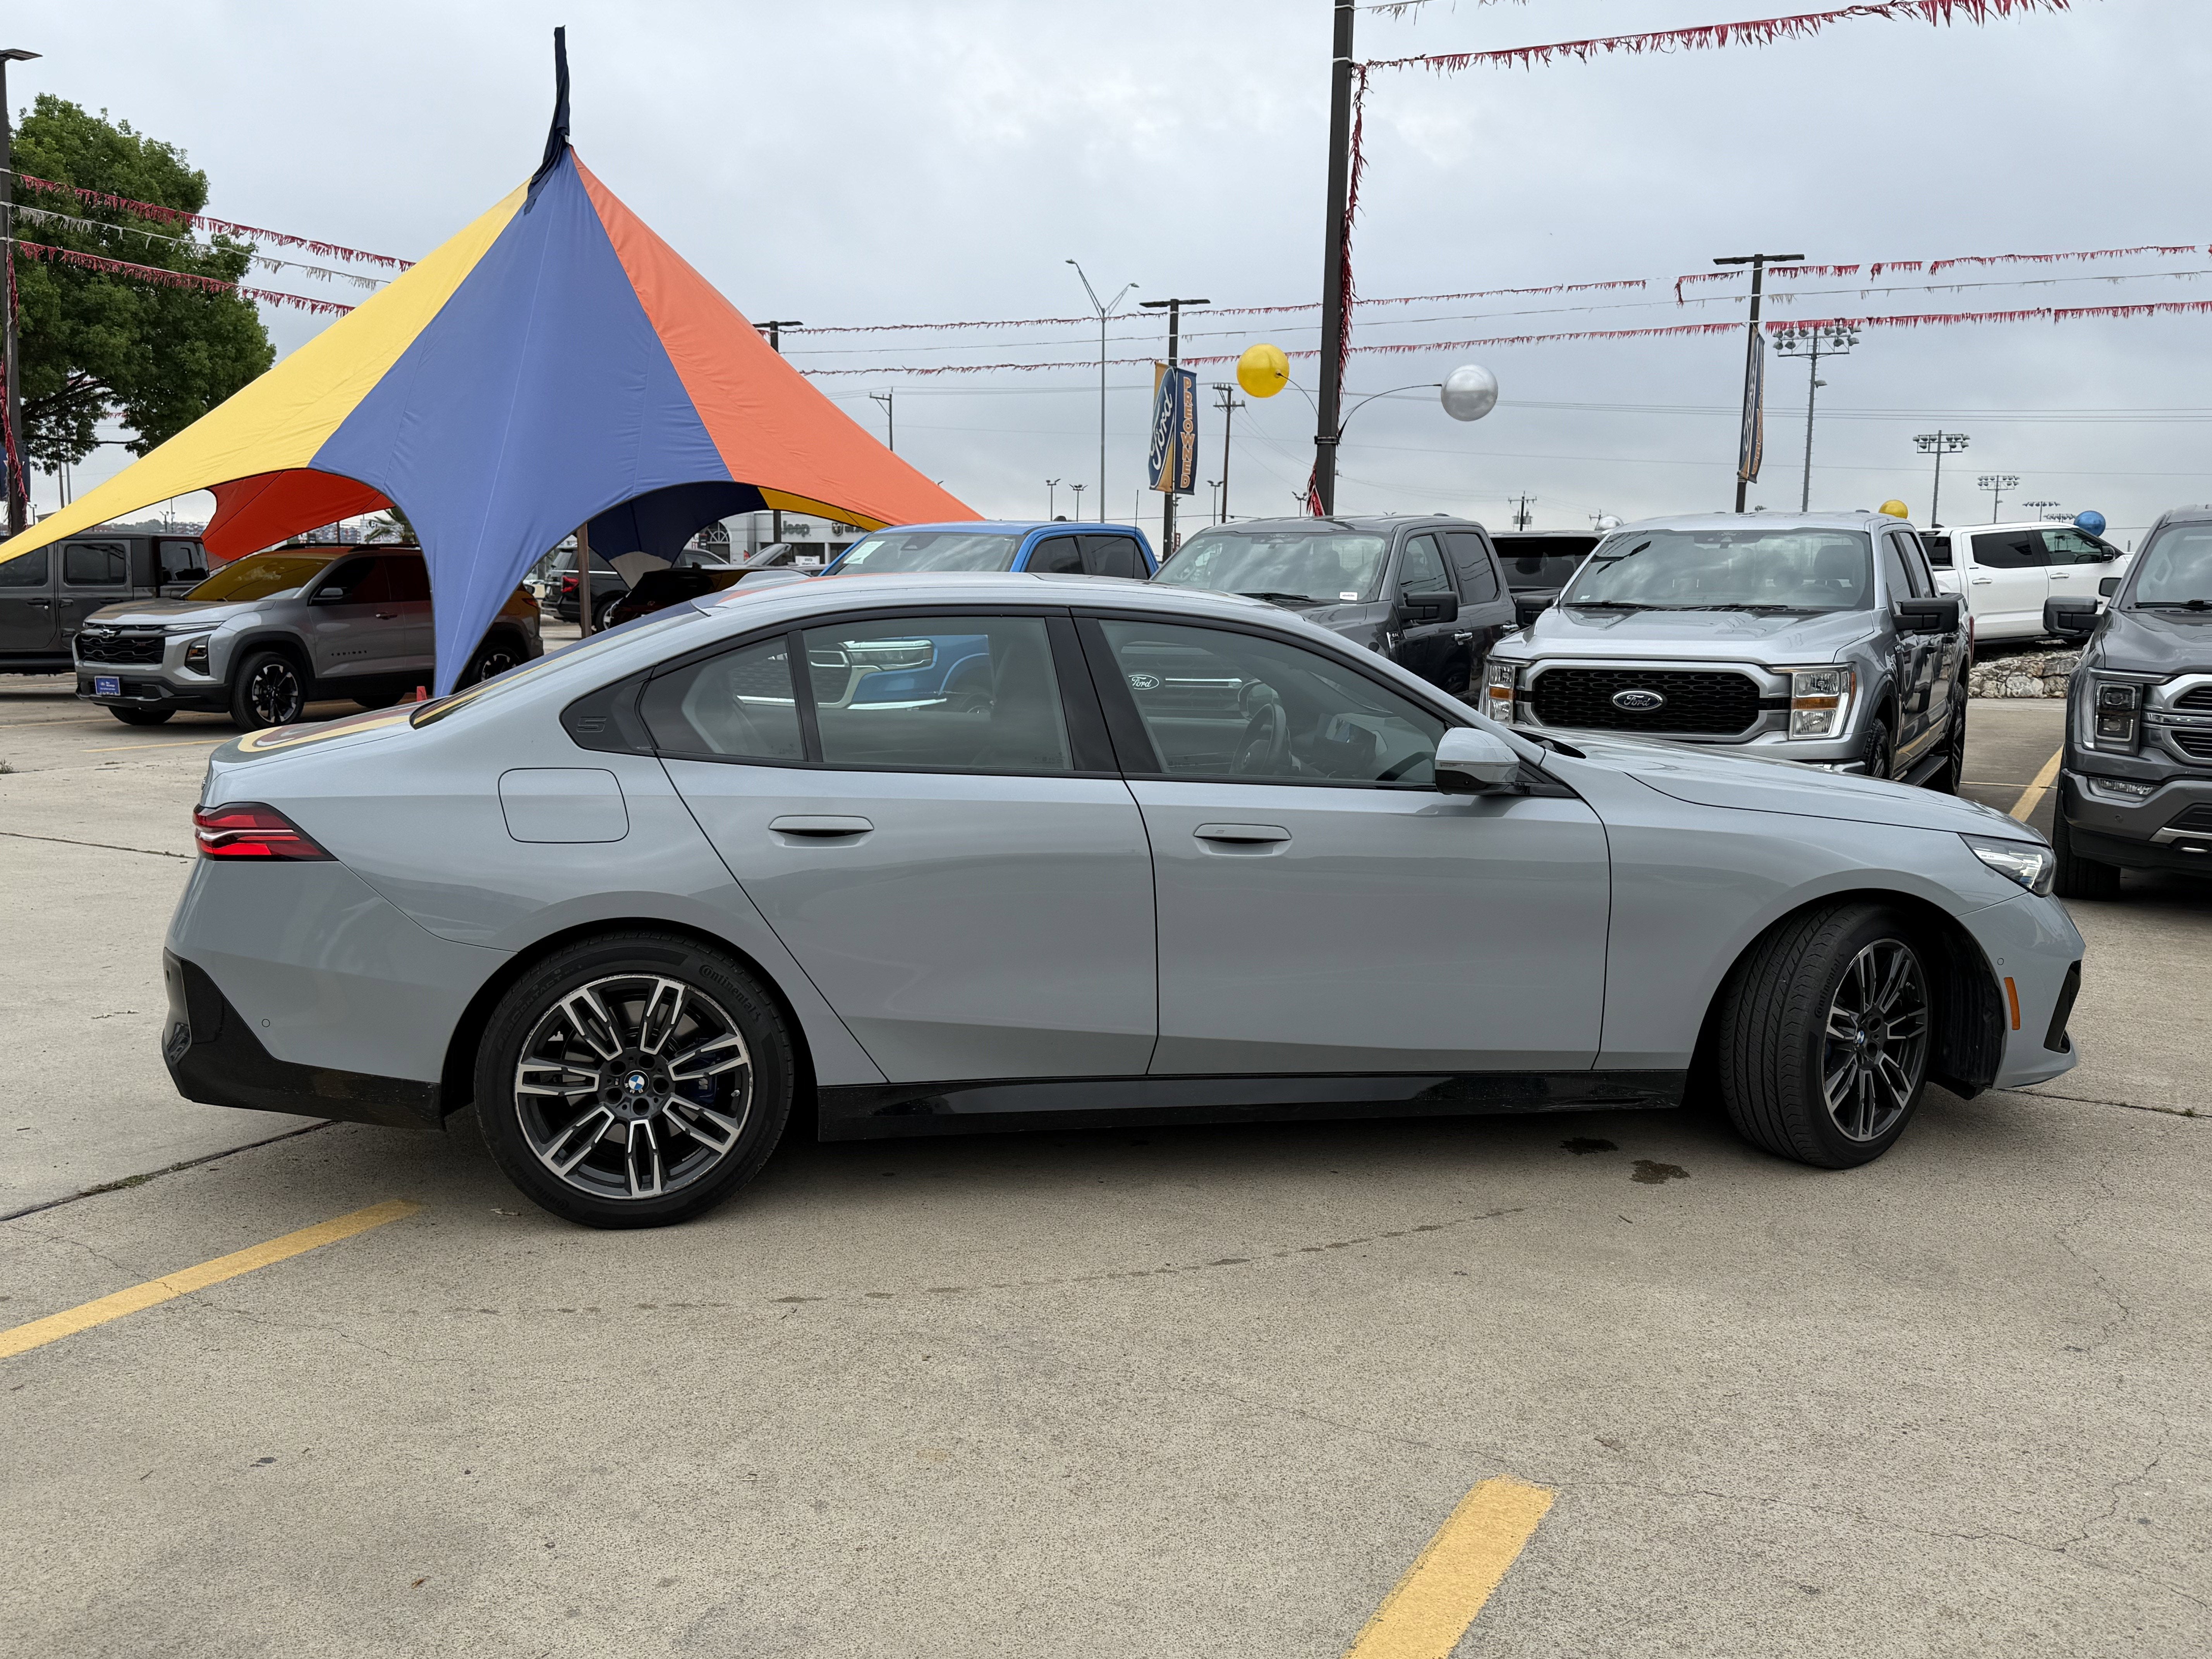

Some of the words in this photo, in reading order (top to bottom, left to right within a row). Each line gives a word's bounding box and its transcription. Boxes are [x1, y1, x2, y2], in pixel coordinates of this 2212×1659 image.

[1149, 386, 1173, 470] Ford
[1180, 376, 1195, 488] PREOWNED
[781, 520, 810, 538] Jeep
[1132, 676, 1152, 687] Ford
[1624, 694, 1650, 706] Ford
[699, 964, 756, 1013] Continental
[1814, 958, 1840, 1018] Continental
